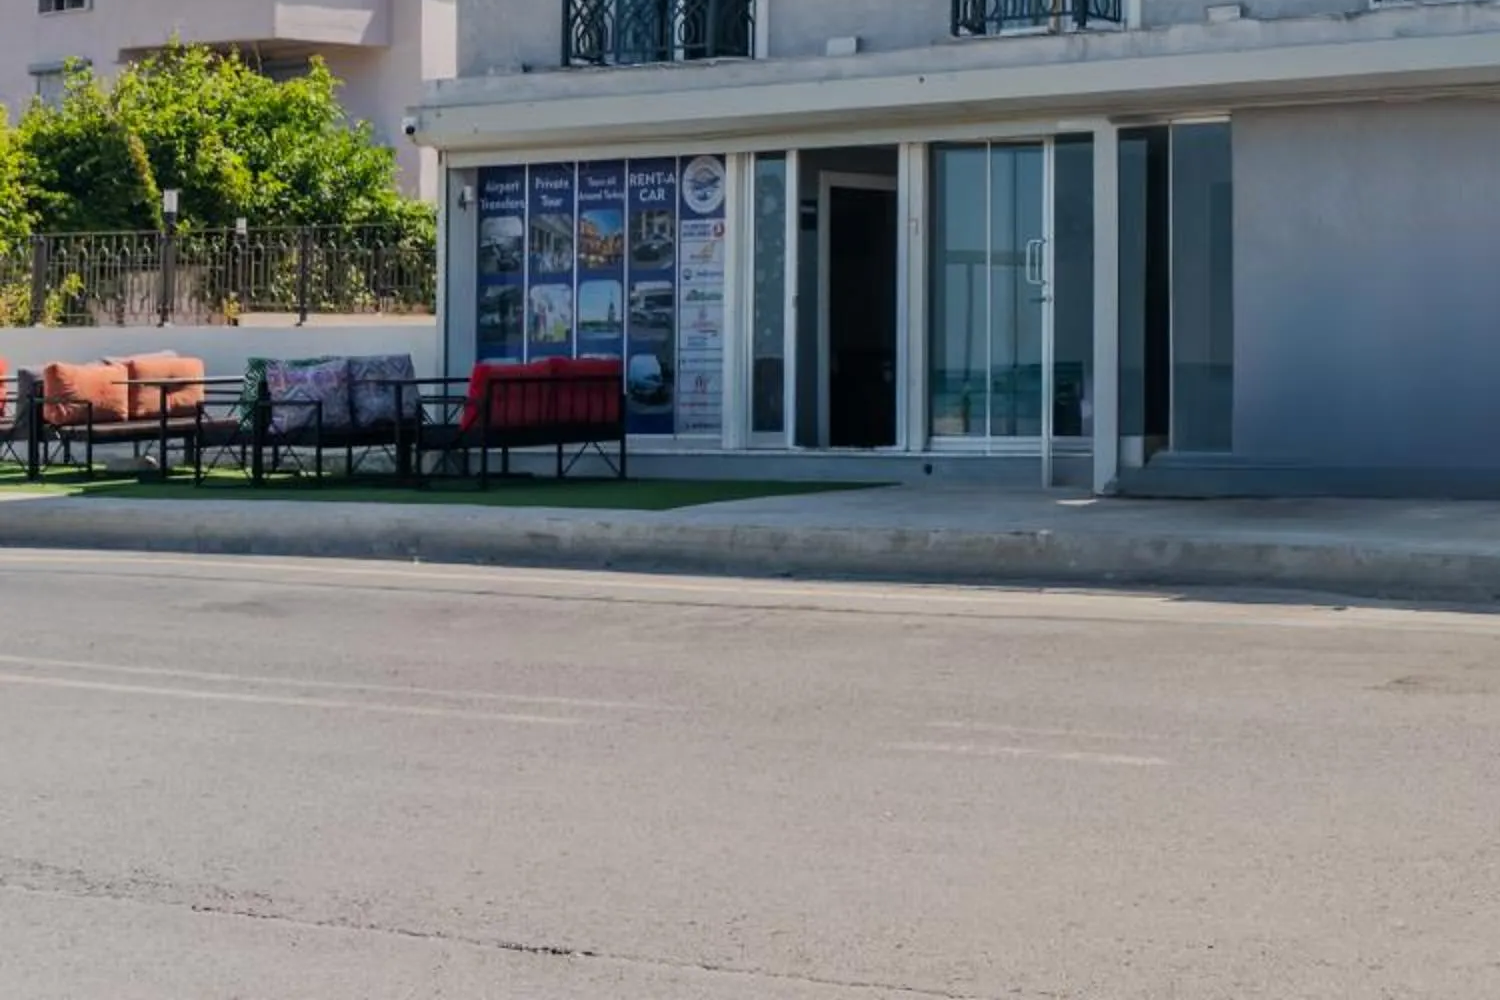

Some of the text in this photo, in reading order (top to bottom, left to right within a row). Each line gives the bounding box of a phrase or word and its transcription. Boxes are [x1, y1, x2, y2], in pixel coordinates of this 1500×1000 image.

[535, 176, 569, 190] Private
[629, 170, 676, 188] RENT-A
[639, 186, 666, 202] CAR
